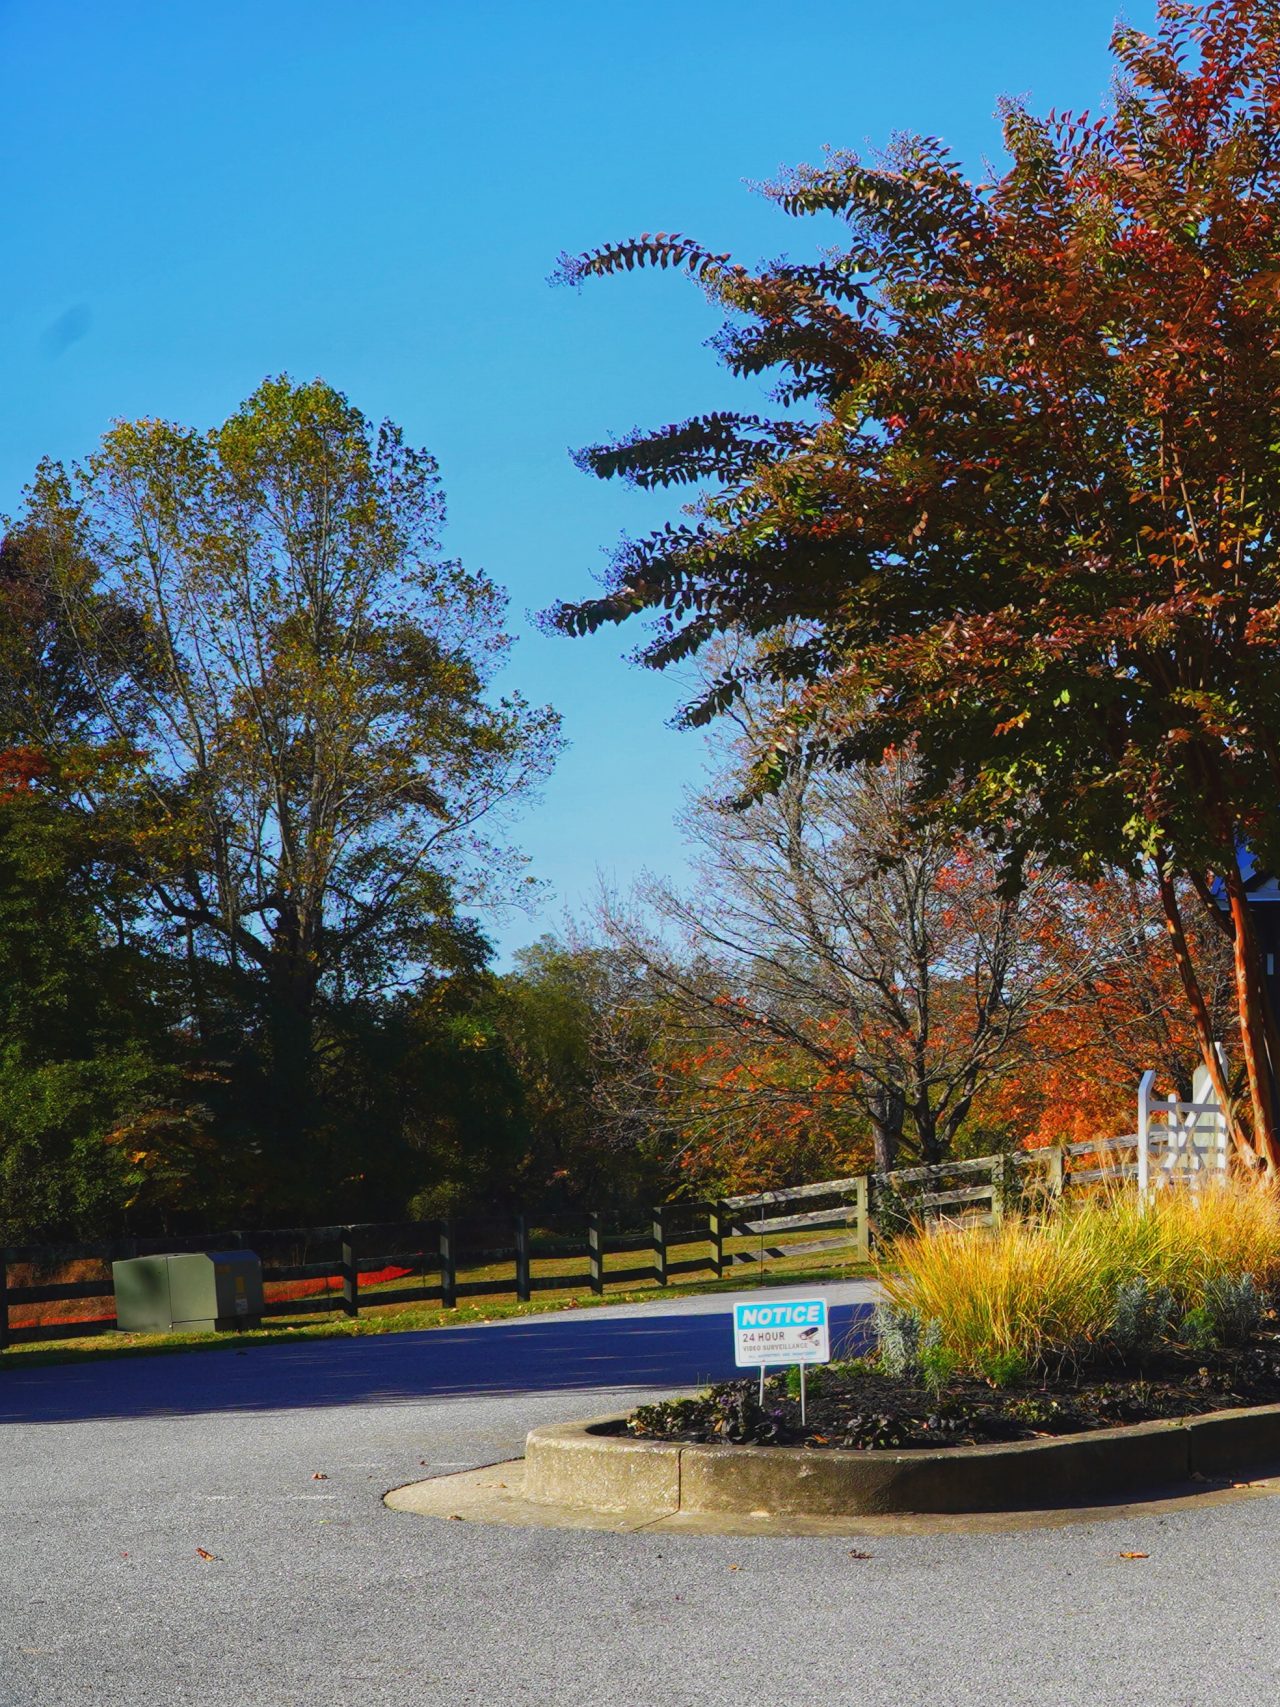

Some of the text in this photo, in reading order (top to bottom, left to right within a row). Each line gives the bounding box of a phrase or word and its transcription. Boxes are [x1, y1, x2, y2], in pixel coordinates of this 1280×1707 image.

[741, 1305, 821, 1326] NOTICE
[743, 1331, 785, 1342] 24 HOUR
[743, 1342, 809, 1352] VIDEO SURVEILLANCE
